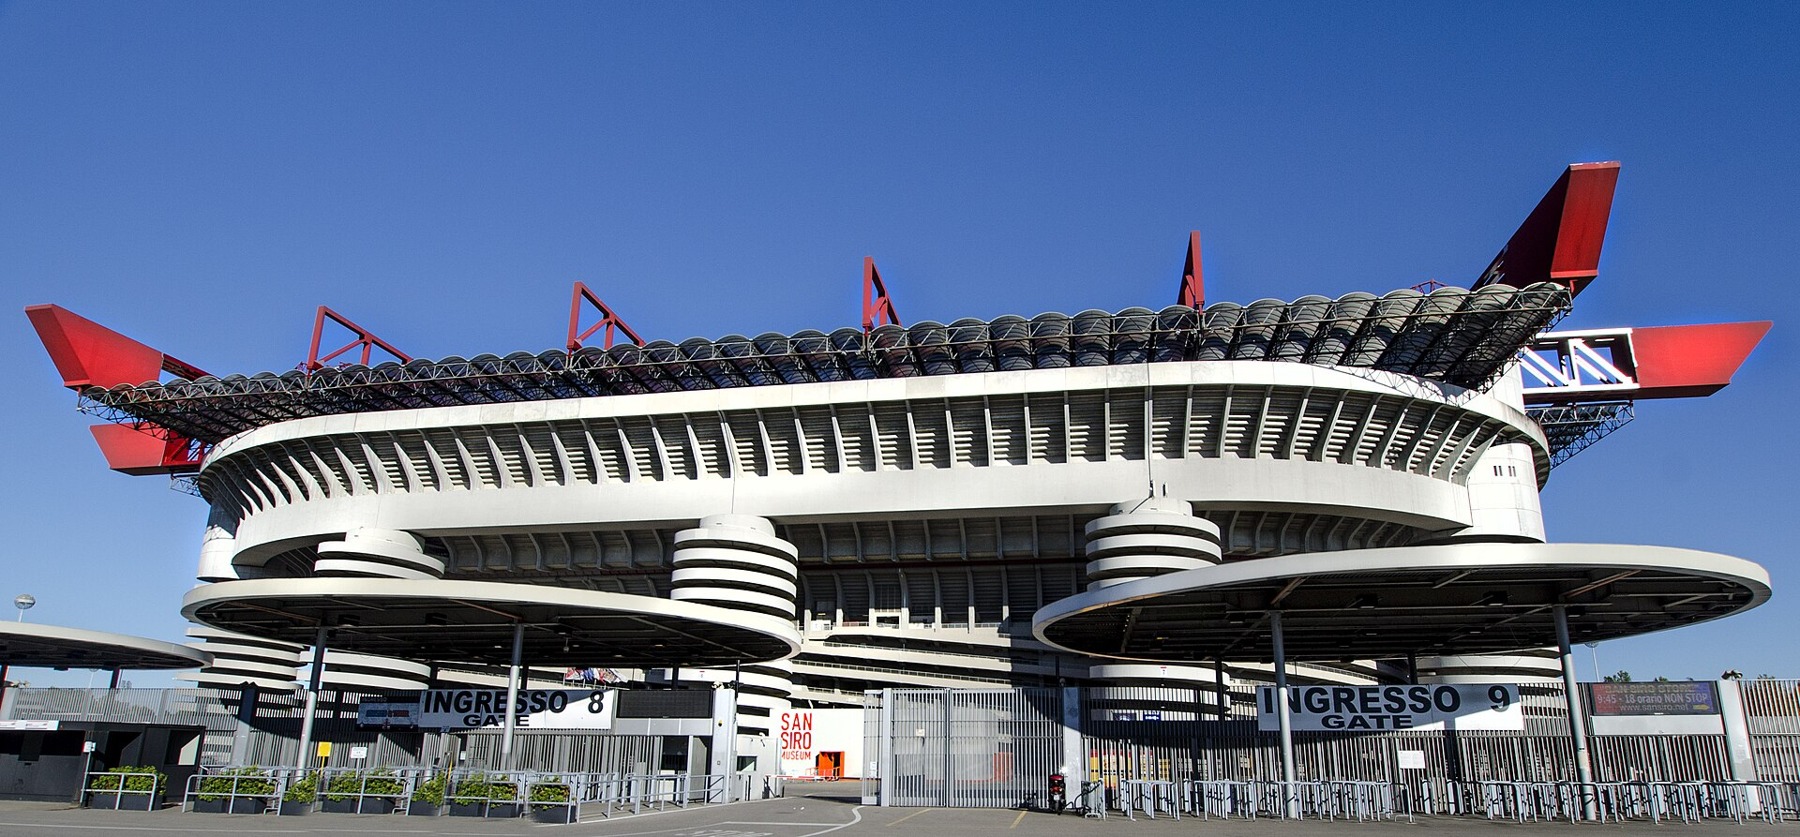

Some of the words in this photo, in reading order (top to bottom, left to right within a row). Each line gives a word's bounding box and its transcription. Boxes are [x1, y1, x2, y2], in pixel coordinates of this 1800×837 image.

[1630, 684, 1656, 693] SIRO
[423, 691, 568, 714] INGRESSO
[588, 691, 604, 714] 8
[1264, 685, 1461, 713] INGRESSO
[1488, 685, 1511, 712] 9
[1597, 694, 1617, 704] 9:45
[1625, 693, 1635, 703] 18
[1637, 694, 1663, 703] orario
[1664, 693, 1684, 703] NON
[1686, 692, 1708, 702] STOP
[1620, 703, 1689, 711] www.sansiro.net
[781, 712, 812, 731] SAN
[1321, 715, 1413, 730] GATE
[781, 731, 812, 750] SIRO
